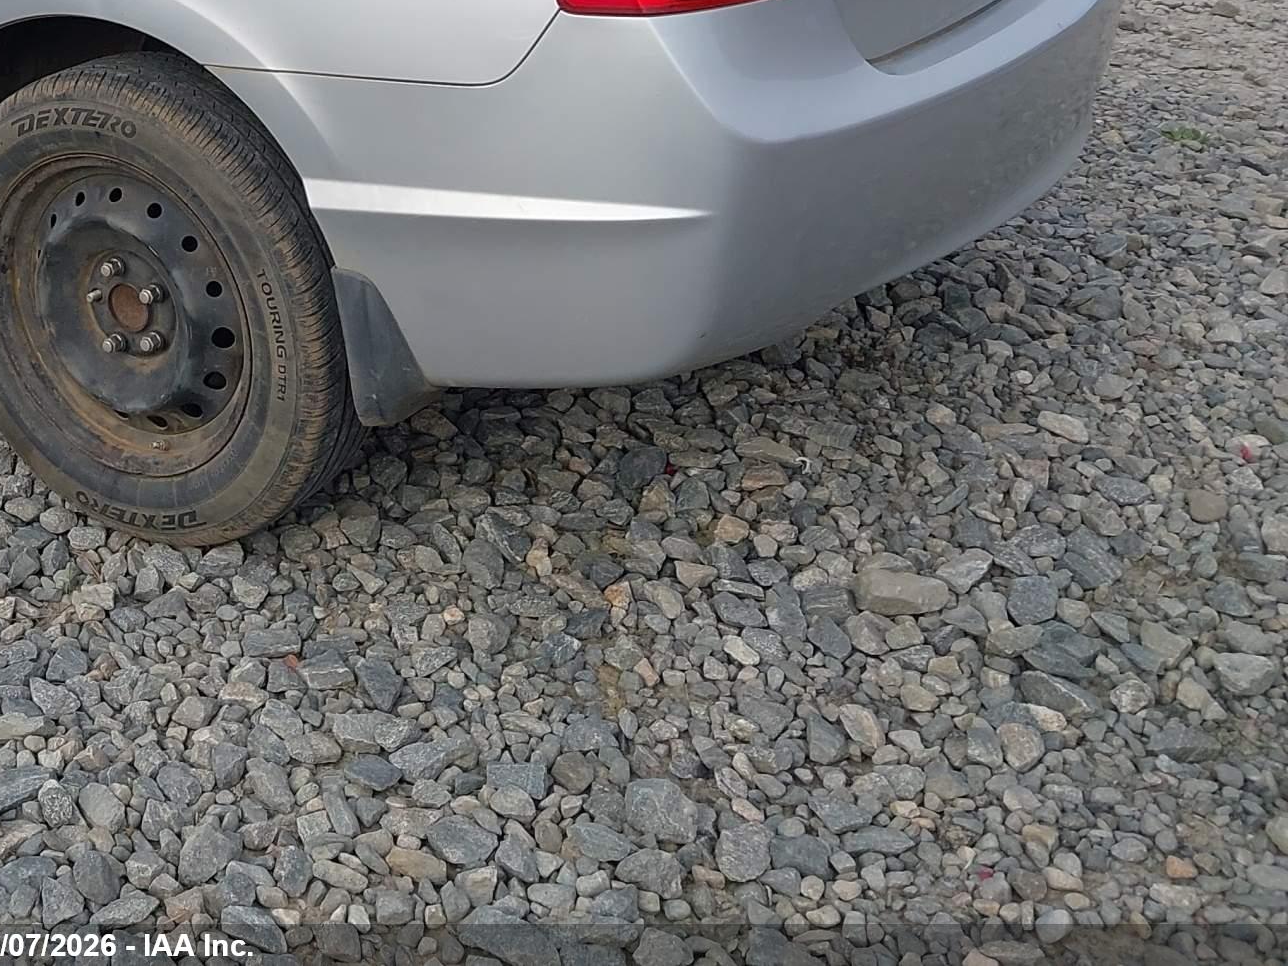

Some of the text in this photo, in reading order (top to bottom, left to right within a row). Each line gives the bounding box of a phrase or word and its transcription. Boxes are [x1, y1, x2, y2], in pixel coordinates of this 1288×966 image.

[10, 107, 137, 139] DEXTERO
[256, 268, 288, 403] TOURING DTR1
[75, 490, 208, 531] DEXTERO
